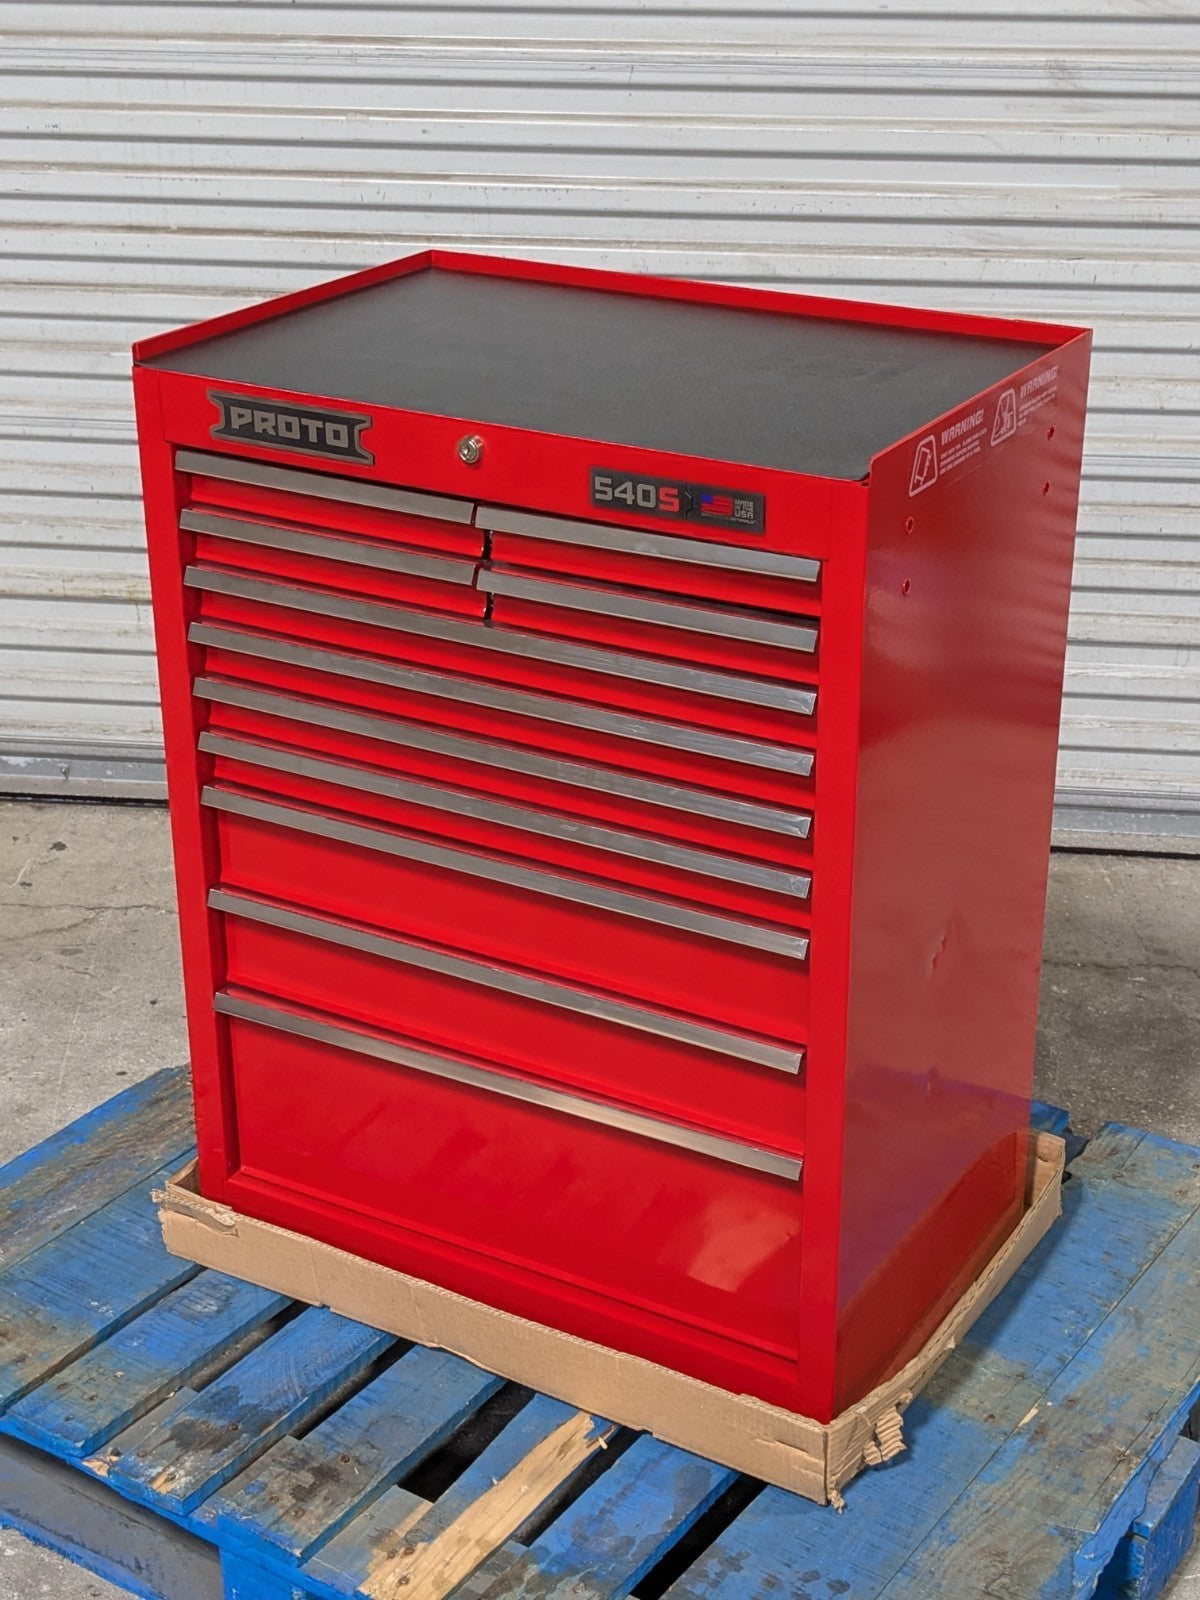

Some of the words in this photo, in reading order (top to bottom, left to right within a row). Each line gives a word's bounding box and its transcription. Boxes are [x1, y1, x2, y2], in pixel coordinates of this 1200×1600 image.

[230, 406, 349, 448] PROTO
[594, 476, 680, 513] 540S
[734, 508, 754, 519] USA
